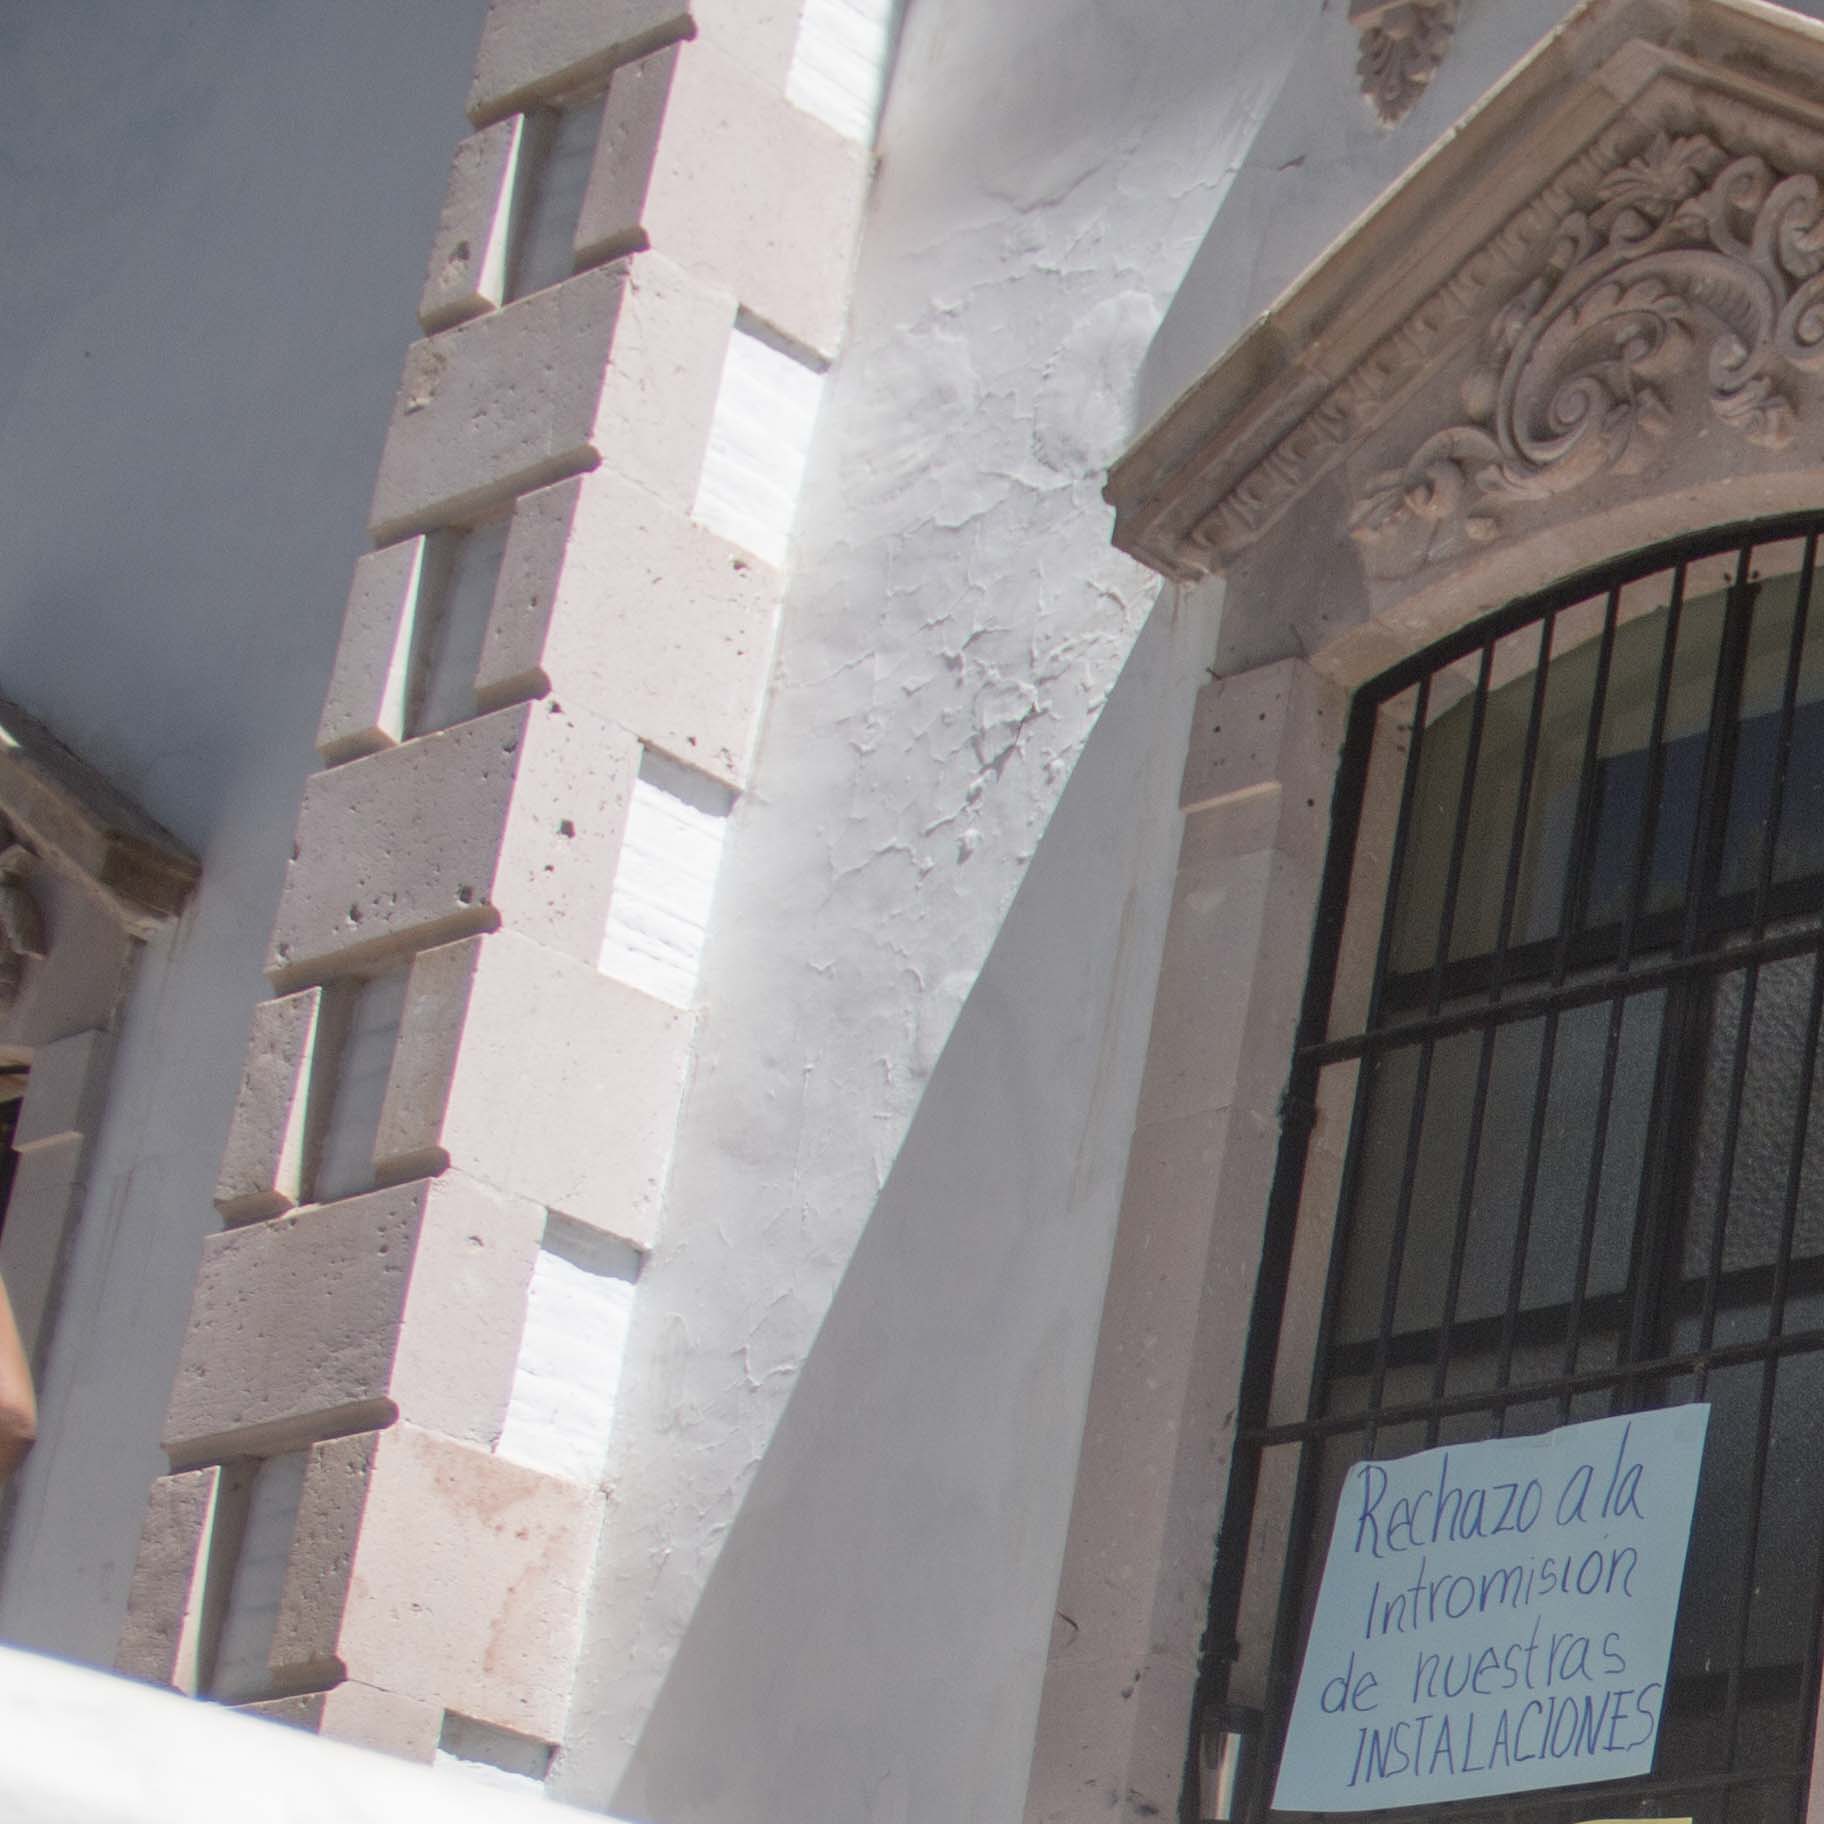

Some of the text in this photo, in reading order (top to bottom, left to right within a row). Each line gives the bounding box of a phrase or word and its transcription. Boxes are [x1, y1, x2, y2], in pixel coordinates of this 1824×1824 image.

[1354, 1420, 1646, 1559] Rechazo a la
[1320, 1614, 1626, 1714] de nuestras
[1346, 1682, 1662, 1788] INSTALACIONES
